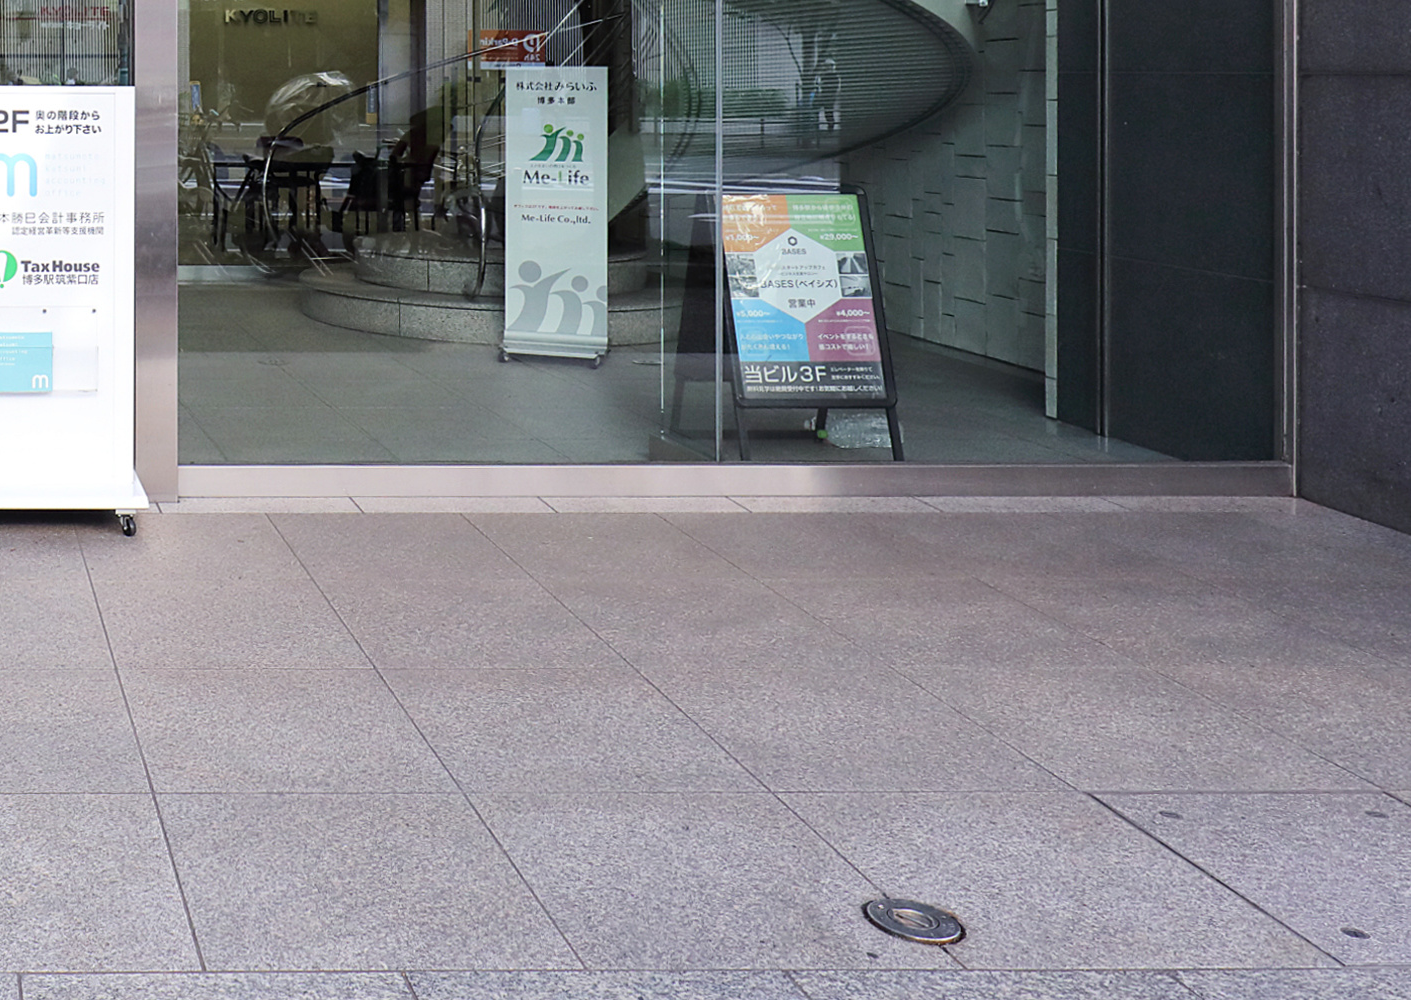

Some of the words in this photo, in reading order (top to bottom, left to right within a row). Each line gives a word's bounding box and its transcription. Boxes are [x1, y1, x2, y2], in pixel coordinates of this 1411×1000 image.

[516, 81, 598, 91] 株式会社みらいふ
[35, 110, 101, 121] 奥の階段から
[35, 124, 102, 135] お上がり下さい
[521, 213, 556, 223] Me-Life
[22, 274, 99, 285] 博多駅筑紫口店
[788, 299, 816, 308] 営業中
